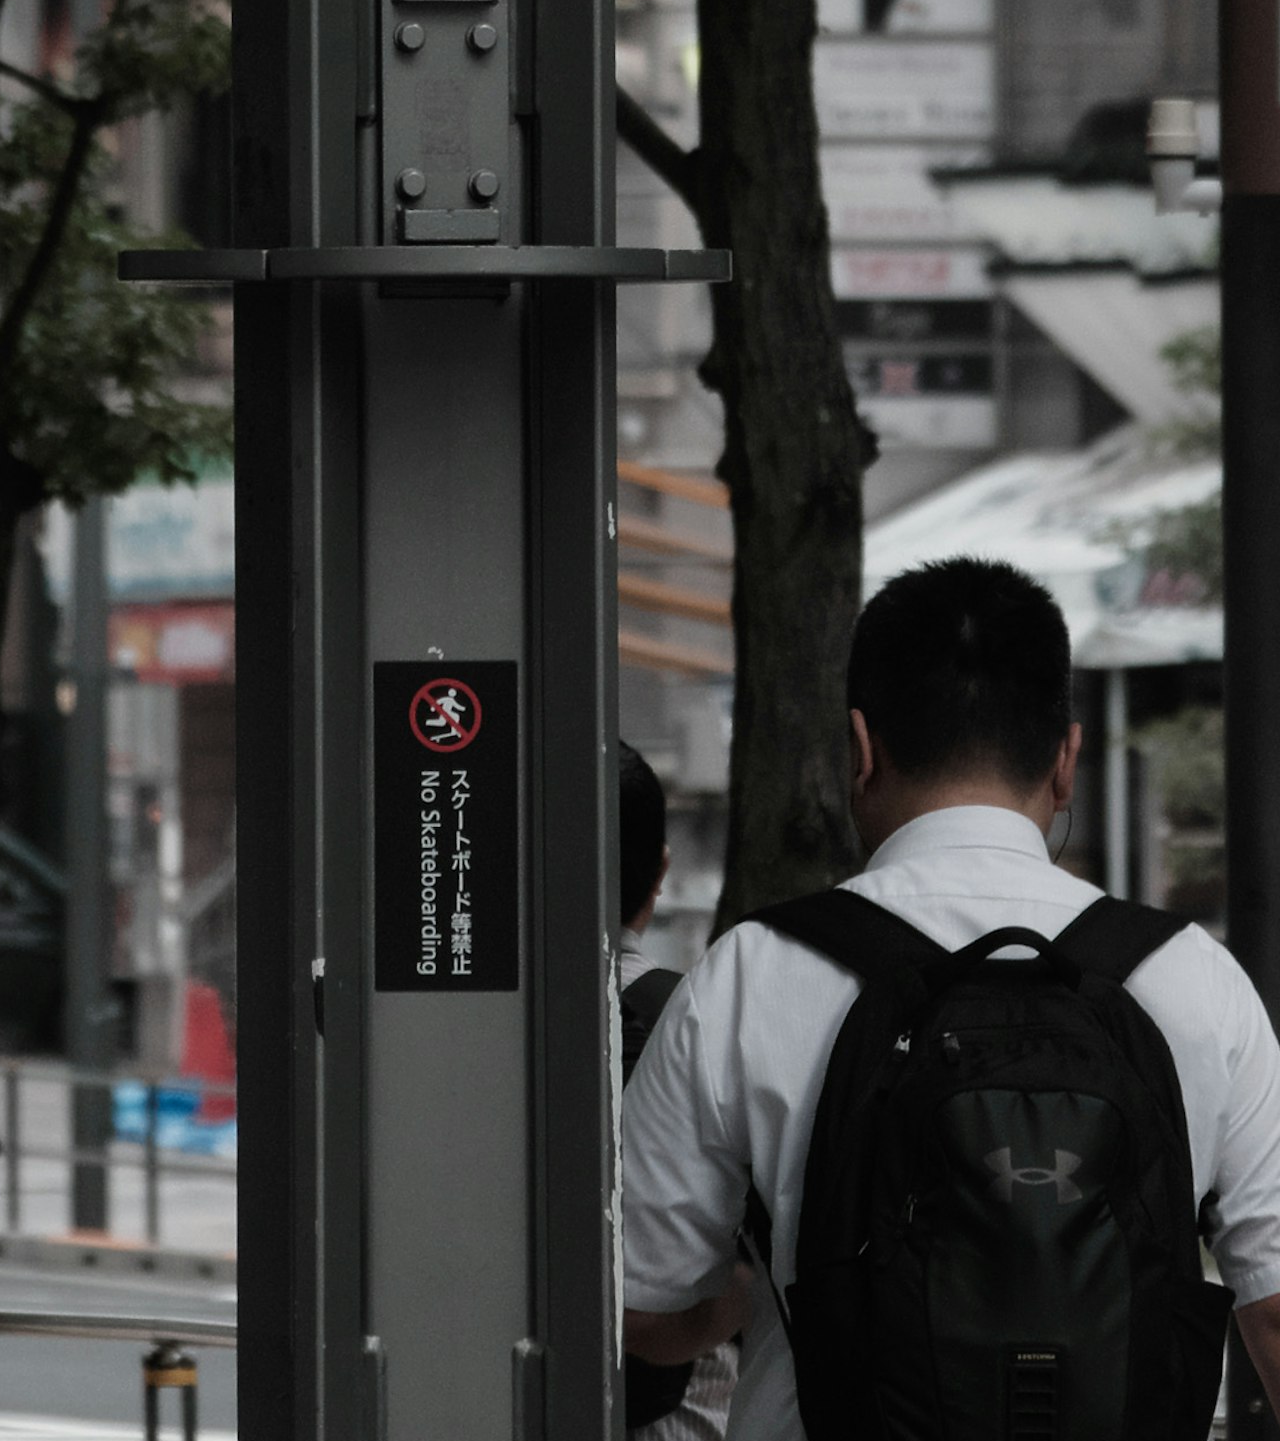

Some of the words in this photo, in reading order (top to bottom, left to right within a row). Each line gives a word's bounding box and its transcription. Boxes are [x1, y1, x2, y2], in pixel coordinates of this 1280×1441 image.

[420, 770, 441, 803] No
[416, 809, 442, 976] Skateboarding
[450, 769, 473, 976] スケートボード等禁止
